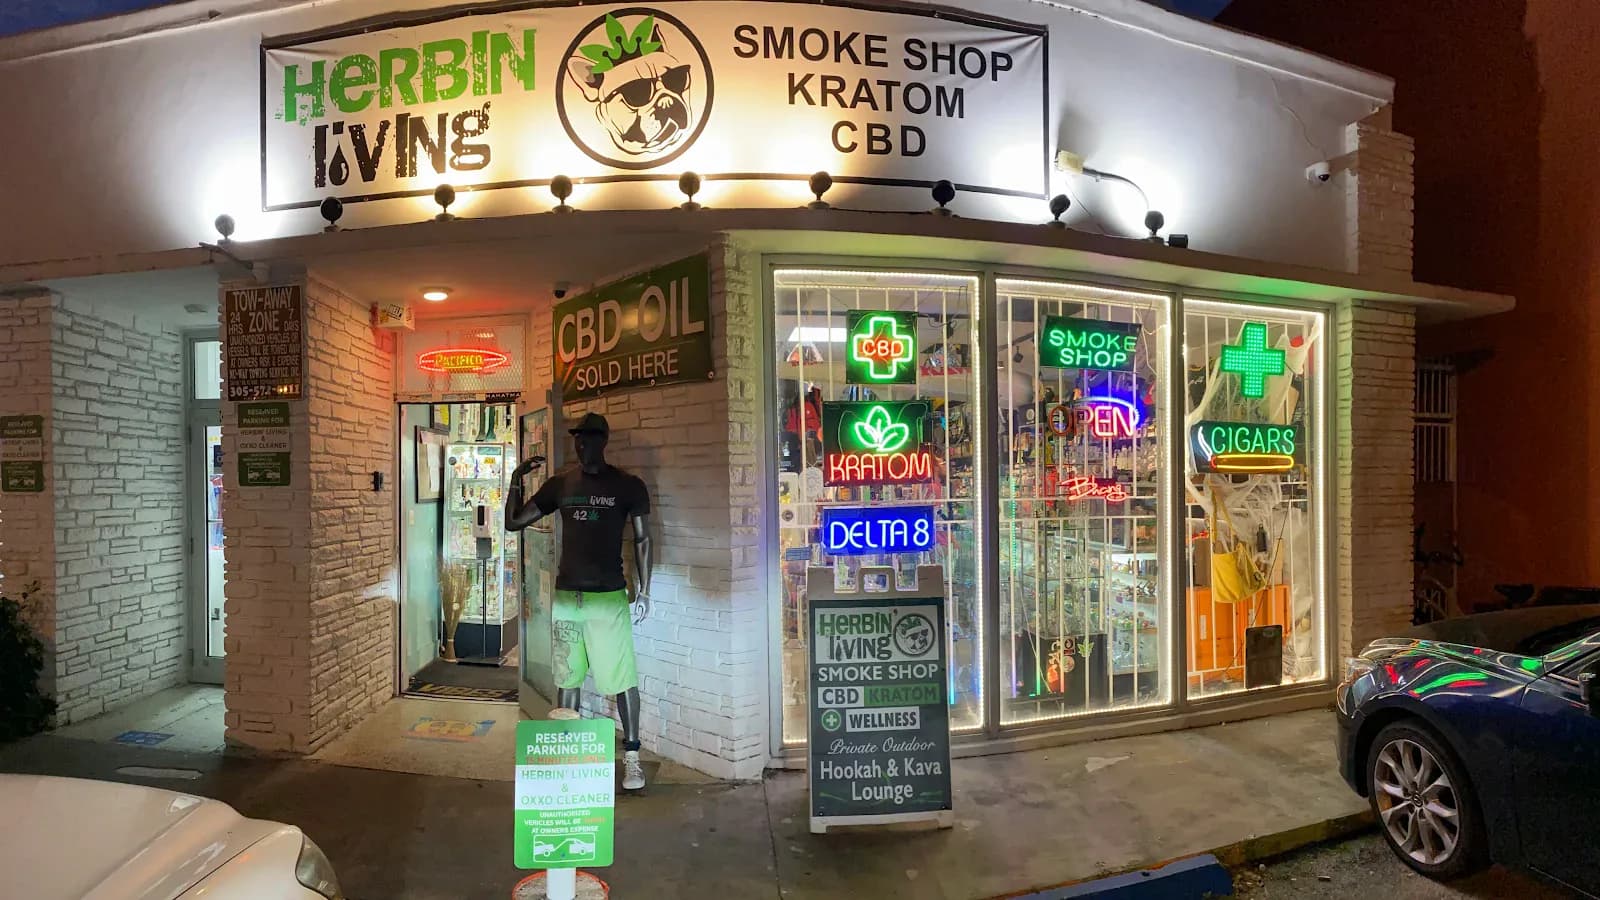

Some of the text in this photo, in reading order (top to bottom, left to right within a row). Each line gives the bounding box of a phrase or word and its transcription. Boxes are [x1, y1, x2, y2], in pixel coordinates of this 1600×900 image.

[733, 24, 1013, 82] SMOKE SHOP
[787, 72, 964, 119] KRATOM
[831, 120, 926, 157] CBD
[232, 287, 293, 312] TOW-AWAY
[228, 323, 243, 336] HRS
[230, 312, 241, 324] 24
[248, 310, 279, 333] ZONE
[557, 276, 705, 364] CBD OIL
[862, 339, 904, 357] CBD
[1049, 329, 1137, 353] SMOKE
[1059, 347, 1127, 368] SHOP
[576, 348, 679, 391] SOLD HERE
[1048, 405, 1134, 437] OPEN
[1211, 426, 1295, 455] CIGARS
[829, 453, 932, 482] KRATOM
[830, 518, 930, 549] DELTA 8
[818, 663, 938, 682] SMOKE SHOP
[822, 687, 937, 705] CBD KRATOM
[849, 711, 917, 729] WELLNESS
[526, 743, 606, 756] PARKING FOR
[535, 732, 597, 744] RESERVED
[827, 735, 936, 755] Private Outdoor
[571, 767, 610, 780] LIVING
[820, 757, 942, 780] Hookah & Kava
[521, 793, 610, 806] OXXO CLEANER
[561, 783, 569, 793] &
[851, 781, 914, 805] Lounge
